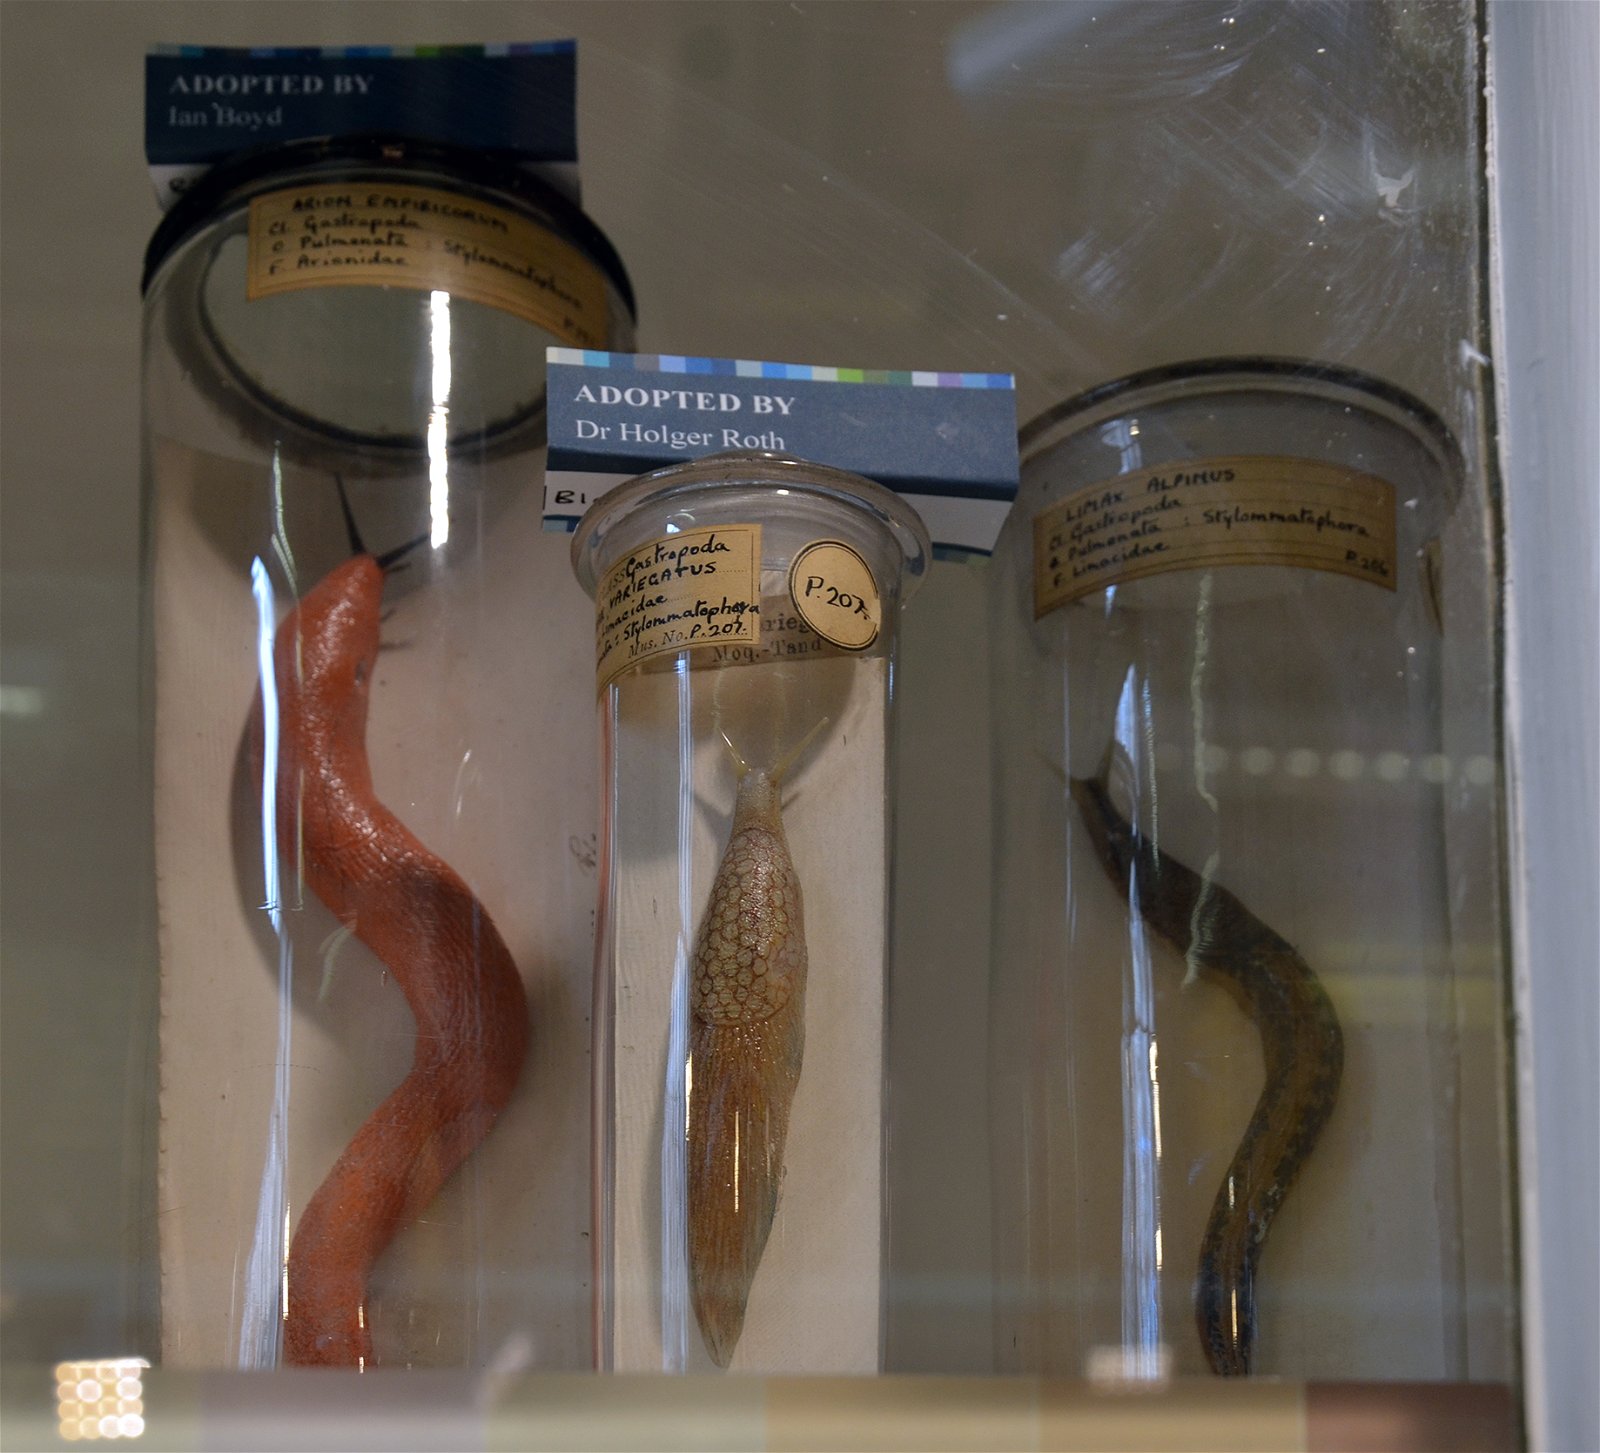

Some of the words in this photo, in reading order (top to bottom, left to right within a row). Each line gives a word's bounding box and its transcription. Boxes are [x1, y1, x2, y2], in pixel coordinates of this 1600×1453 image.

[169, 75, 324, 95] ADOPTED
[334, 75, 374, 95] BY
[169, 106, 208, 127] Ian
[214, 104, 283, 132] Boyd
[300, 231, 408, 249] Pulmonata
[304, 214, 422, 235] Gastropoda
[574, 384, 742, 412] ADOPTED
[753, 395, 796, 415] BY
[576, 419, 612, 439] Dr
[619, 422, 713, 450] Holger
[722, 428, 786, 450] Roth
[1066, 491, 1124, 522] LIMAX
[1147, 468, 1235, 493] ALPINUS
[1068, 519, 1162, 562] Pulmonata
[1202, 506, 1370, 538] Stylommatophora
[1070, 495, 1182, 542] Gastropoda
[625, 533, 731, 584] Gastropoda
[1073, 542, 1168, 579] Limacidae
[609, 561, 717, 609] VARIEGATUS
[628, 638, 658, 659] Mus.
[662, 630, 689, 646] No.
